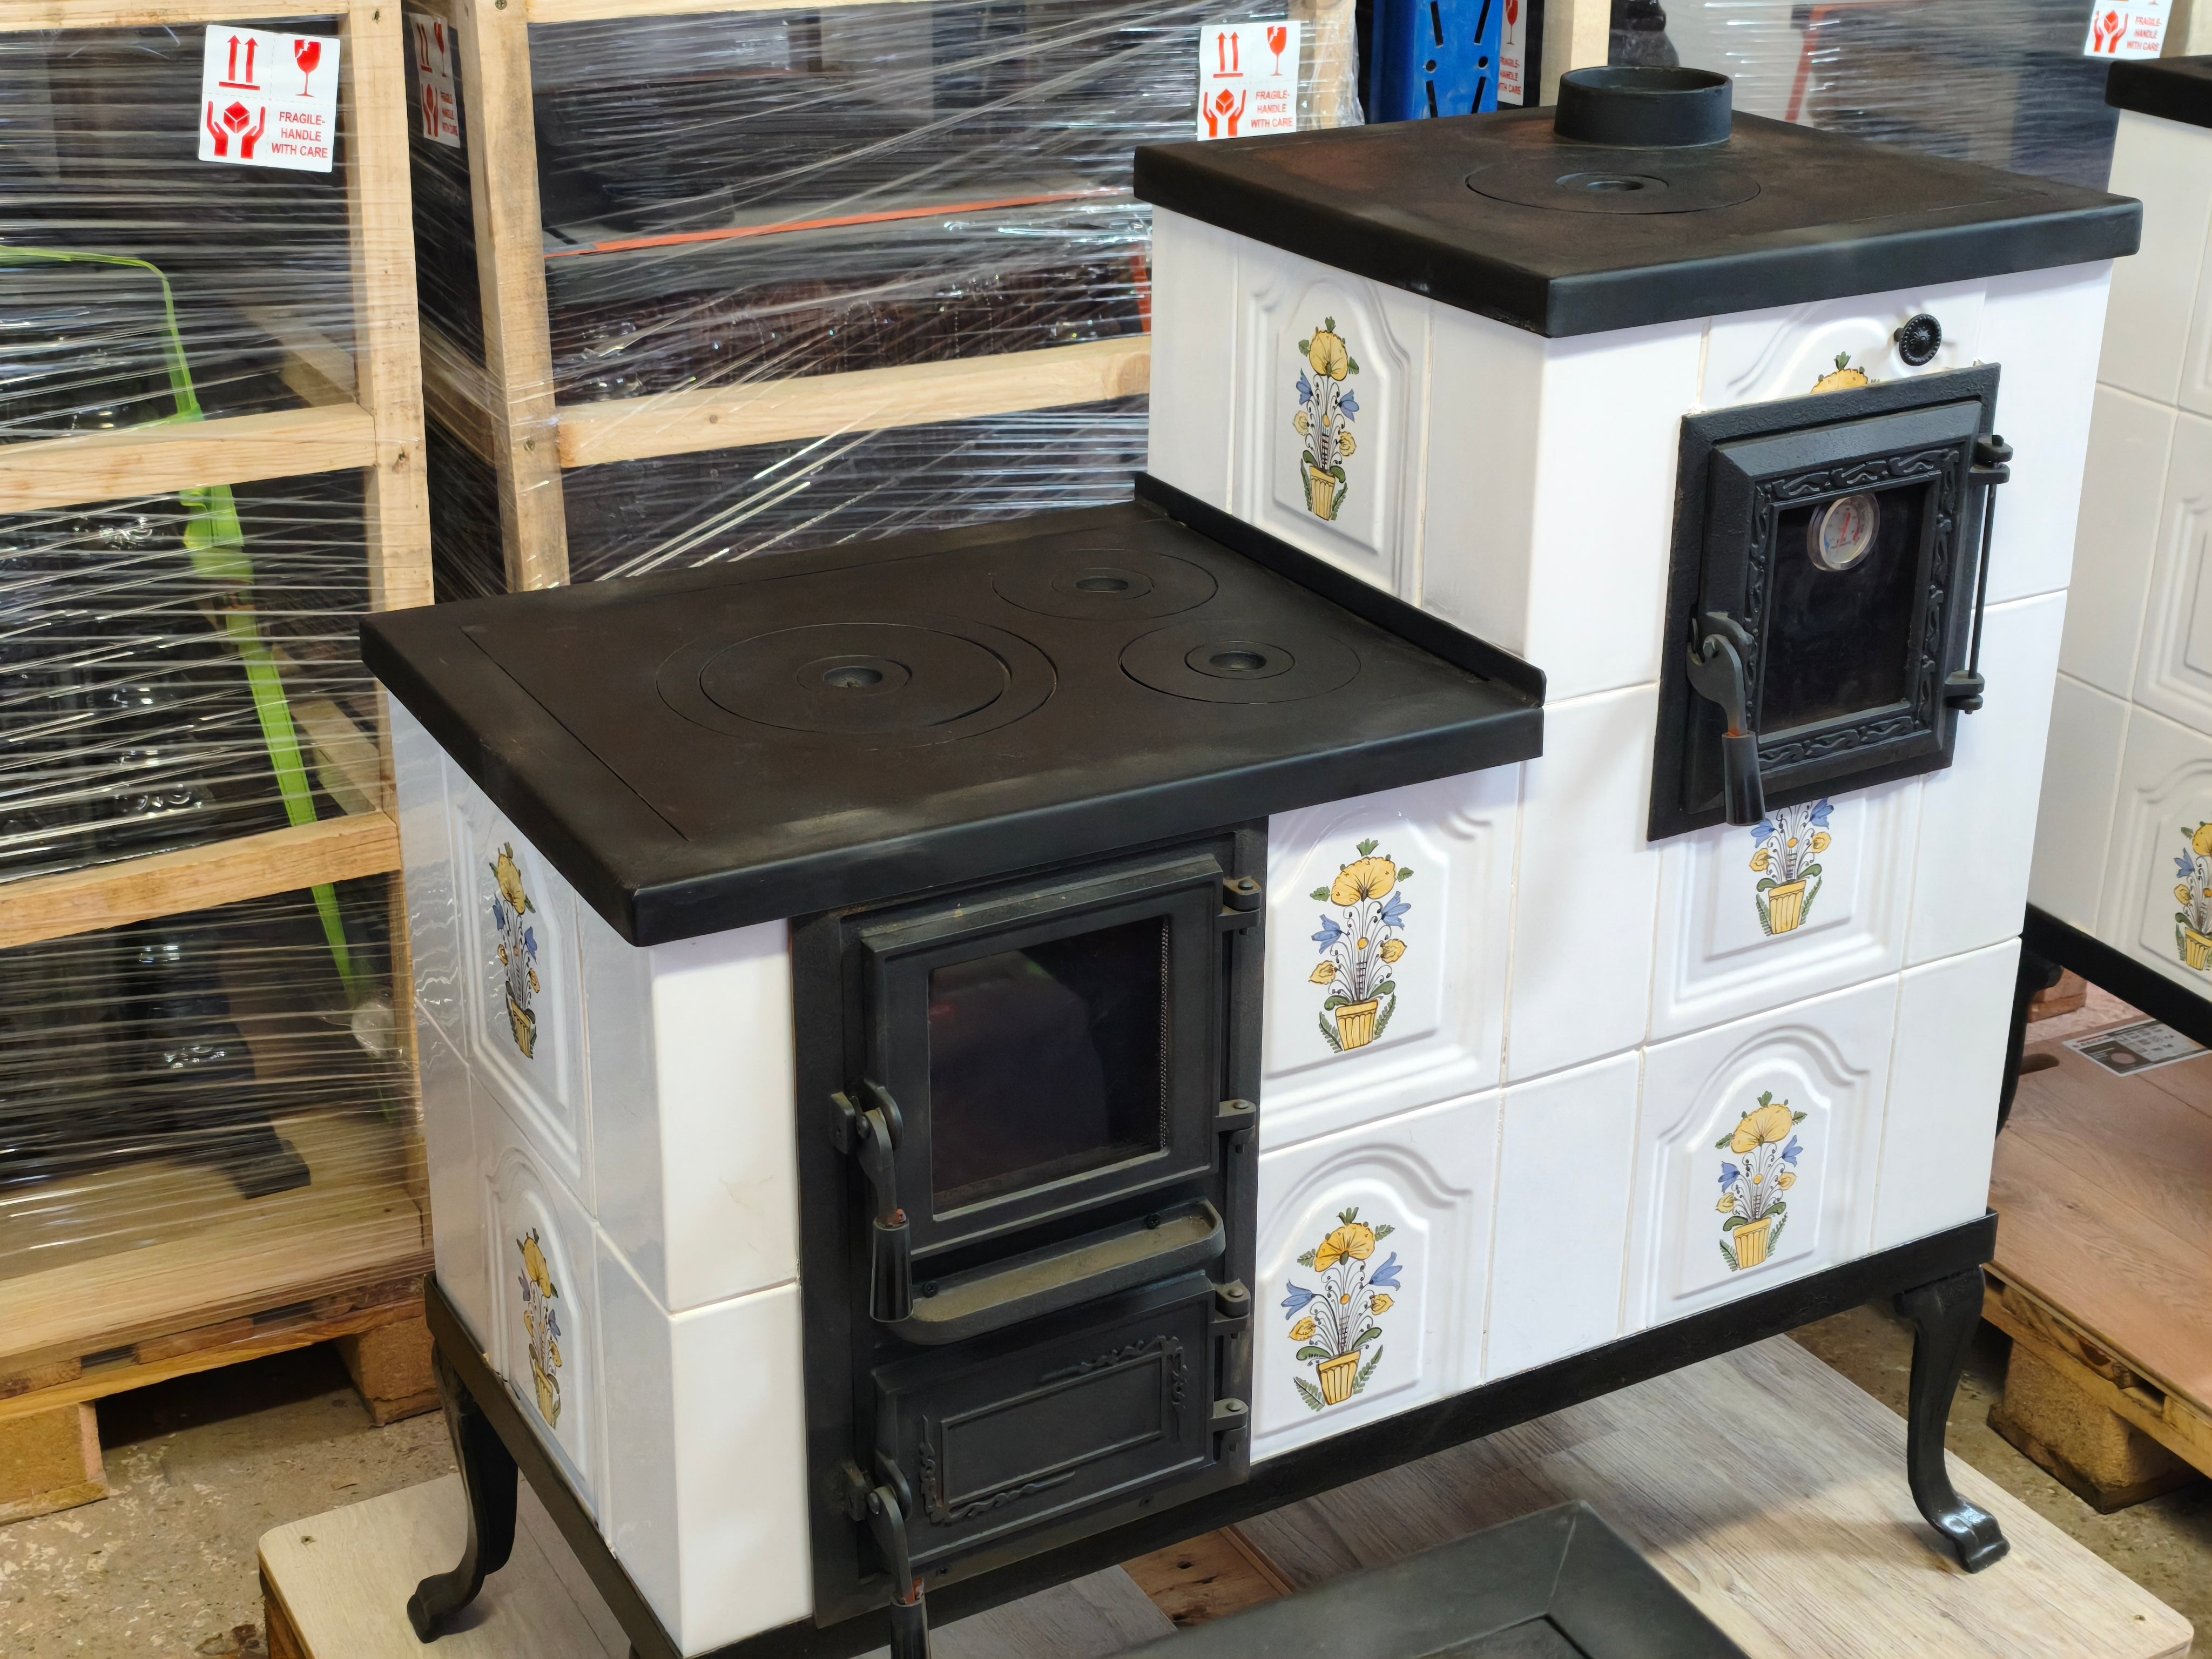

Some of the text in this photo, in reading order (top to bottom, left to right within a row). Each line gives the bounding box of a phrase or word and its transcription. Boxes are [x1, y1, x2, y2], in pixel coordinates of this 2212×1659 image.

[1257, 104, 1287, 113] HANDLE
[279, 111, 325, 125] FRAGILE-
[1251, 117, 1293, 128] WITH CARE
[281, 128, 321, 141] HANDLE
[272, 143, 328, 158] WITH CARE
